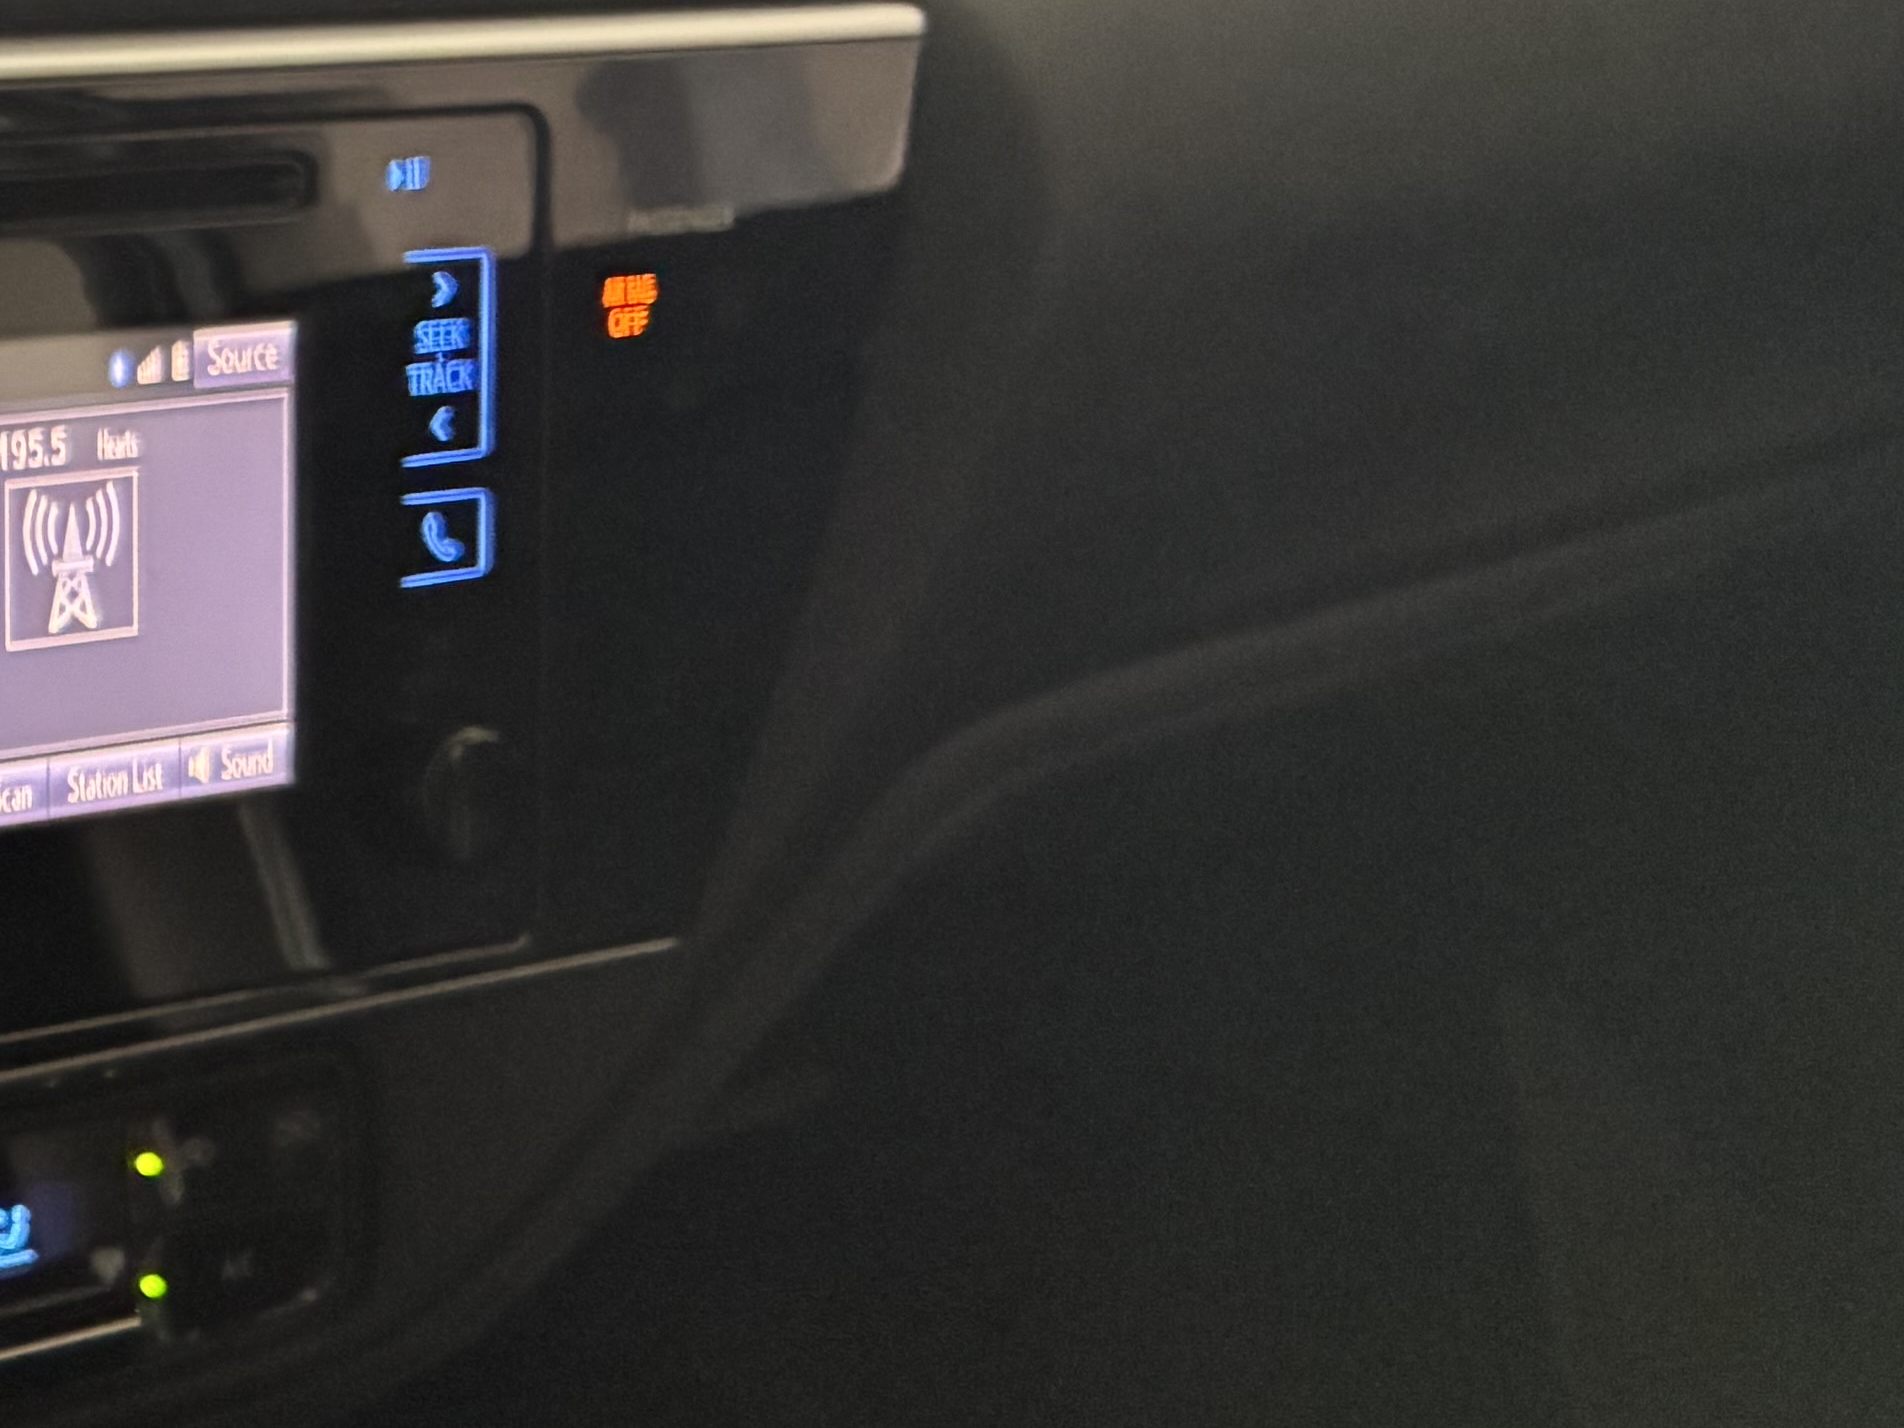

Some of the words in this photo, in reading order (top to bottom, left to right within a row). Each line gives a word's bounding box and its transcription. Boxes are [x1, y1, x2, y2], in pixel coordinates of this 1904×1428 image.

[413, 317, 471, 355] SEEK
[207, 339, 280, 377] Source
[406, 358, 479, 397] TRACK
[220, 738, 275, 781] Sound
[66, 767, 129, 805] Station
[131, 758, 164, 793] List
